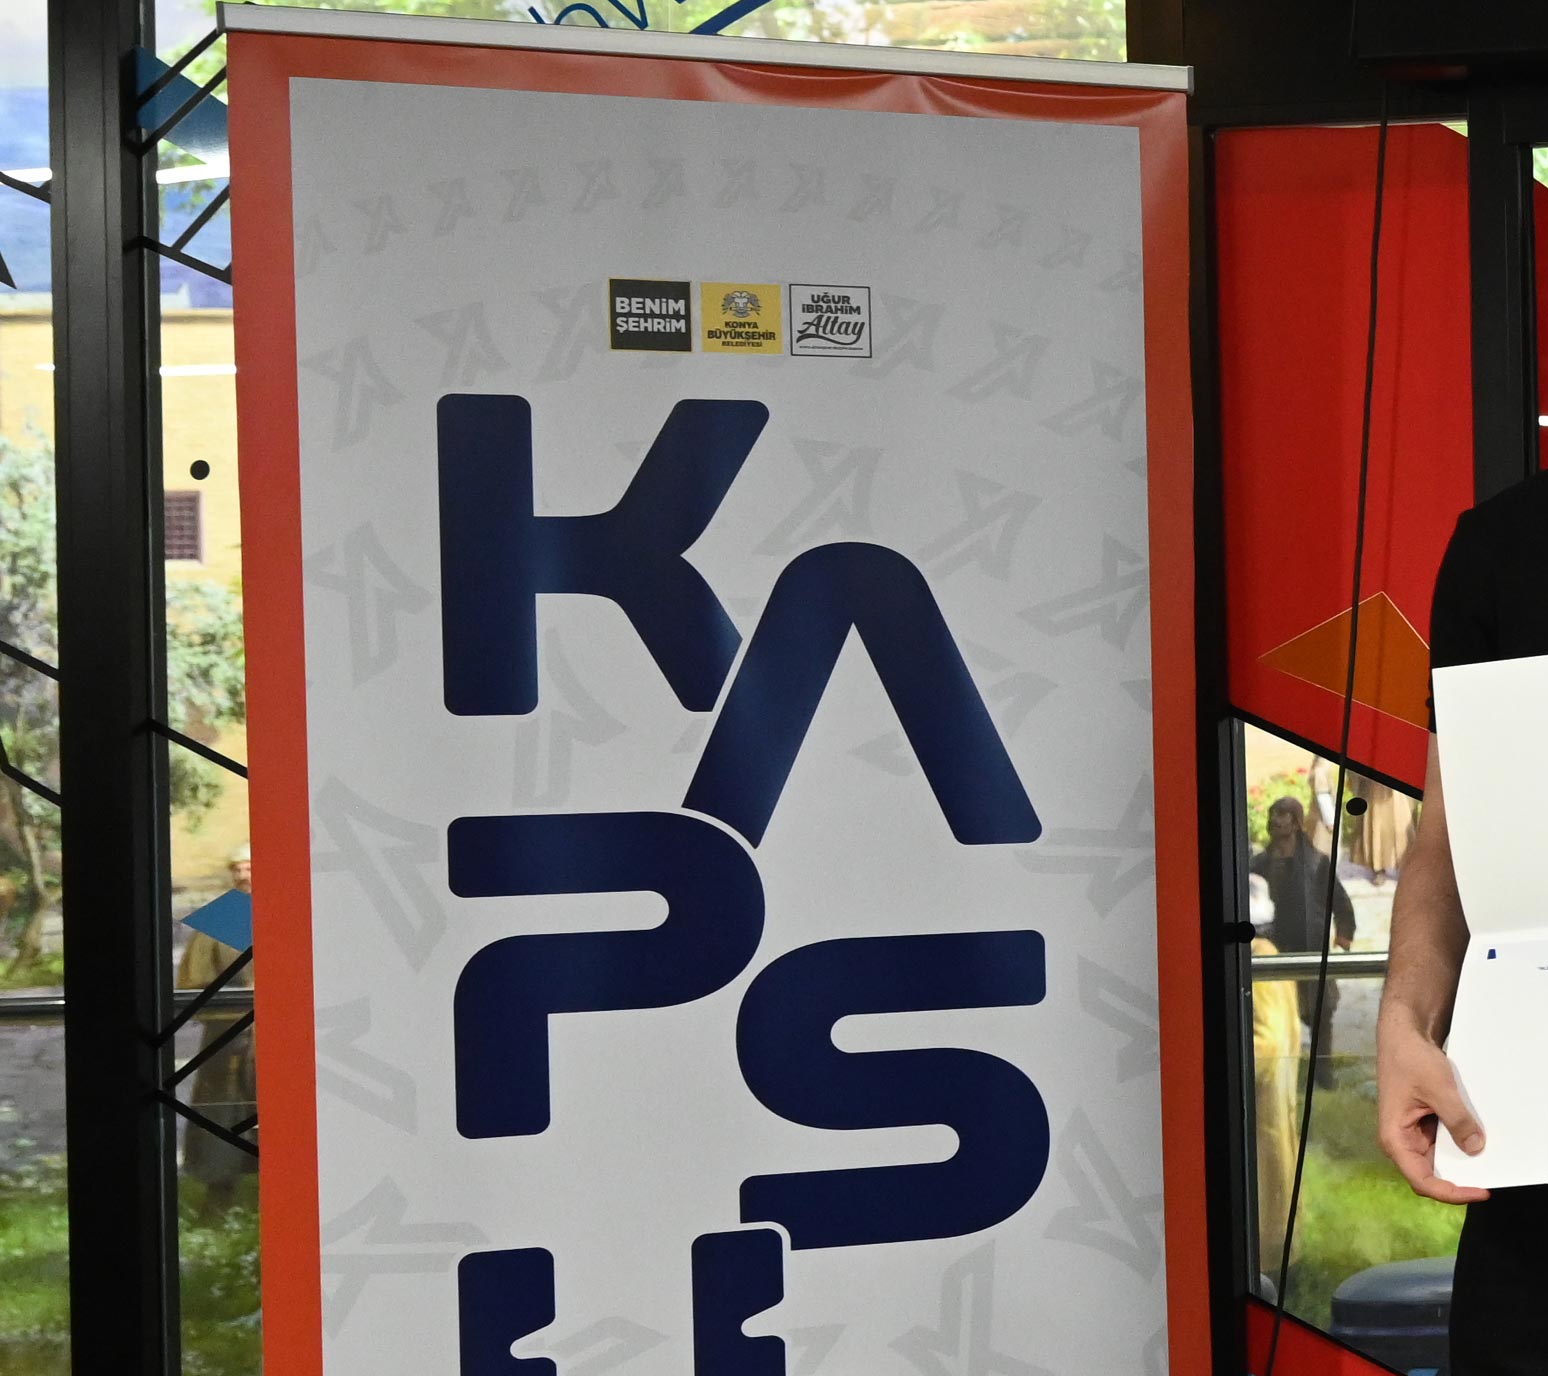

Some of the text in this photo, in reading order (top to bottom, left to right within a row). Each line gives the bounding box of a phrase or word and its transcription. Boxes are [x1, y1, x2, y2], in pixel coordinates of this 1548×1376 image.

[811, 292, 851, 305] UĞUR
[724, 321, 759, 330] KONYA
[797, 315, 865, 345] Altay
[707, 329, 776, 341] BÜYÜKŞEHİR
